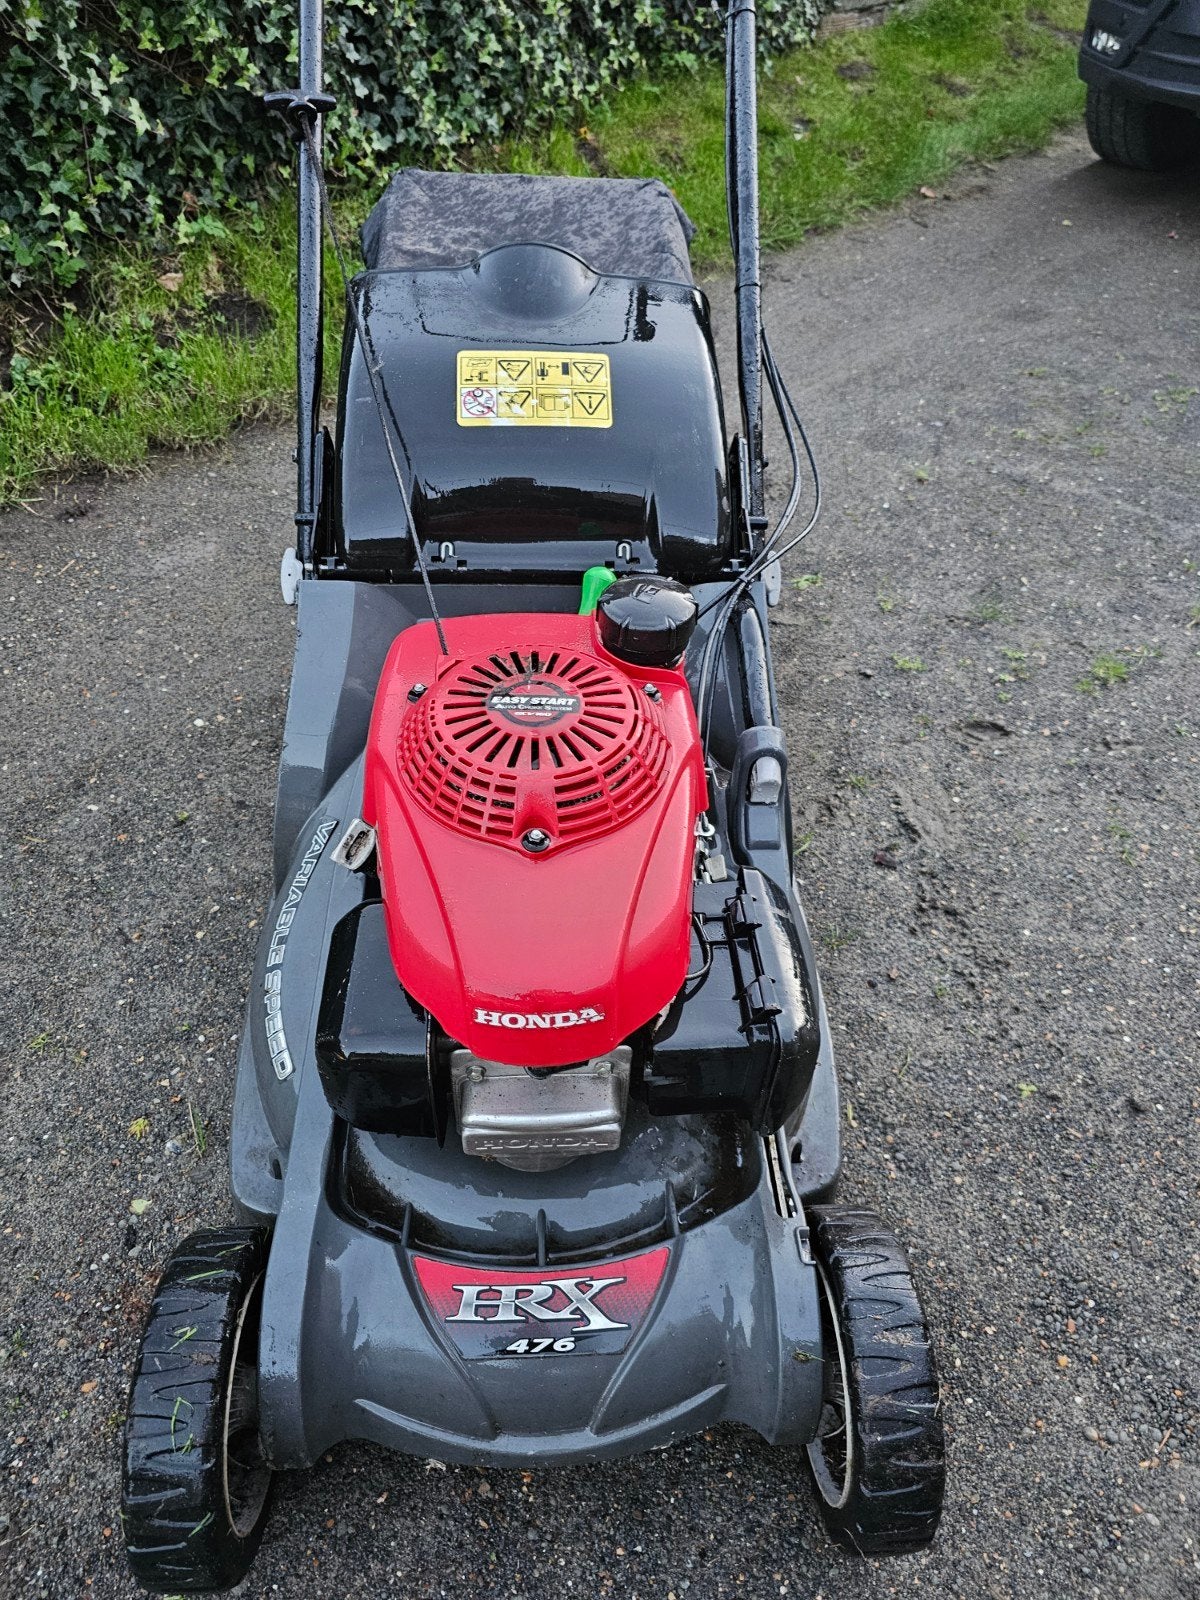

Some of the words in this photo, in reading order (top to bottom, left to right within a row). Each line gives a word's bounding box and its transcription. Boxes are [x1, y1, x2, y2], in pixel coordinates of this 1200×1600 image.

[491, 696, 529, 704] EASY
[530, 697, 576, 706] START
[267, 820, 338, 967] VARIABLE
[264, 969, 294, 1081] SPEED
[473, 1007, 605, 1029] HONDA
[474, 1136, 609, 1150] HONDA
[444, 1276, 631, 1334] HRX
[505, 1336, 577, 1354] 476
